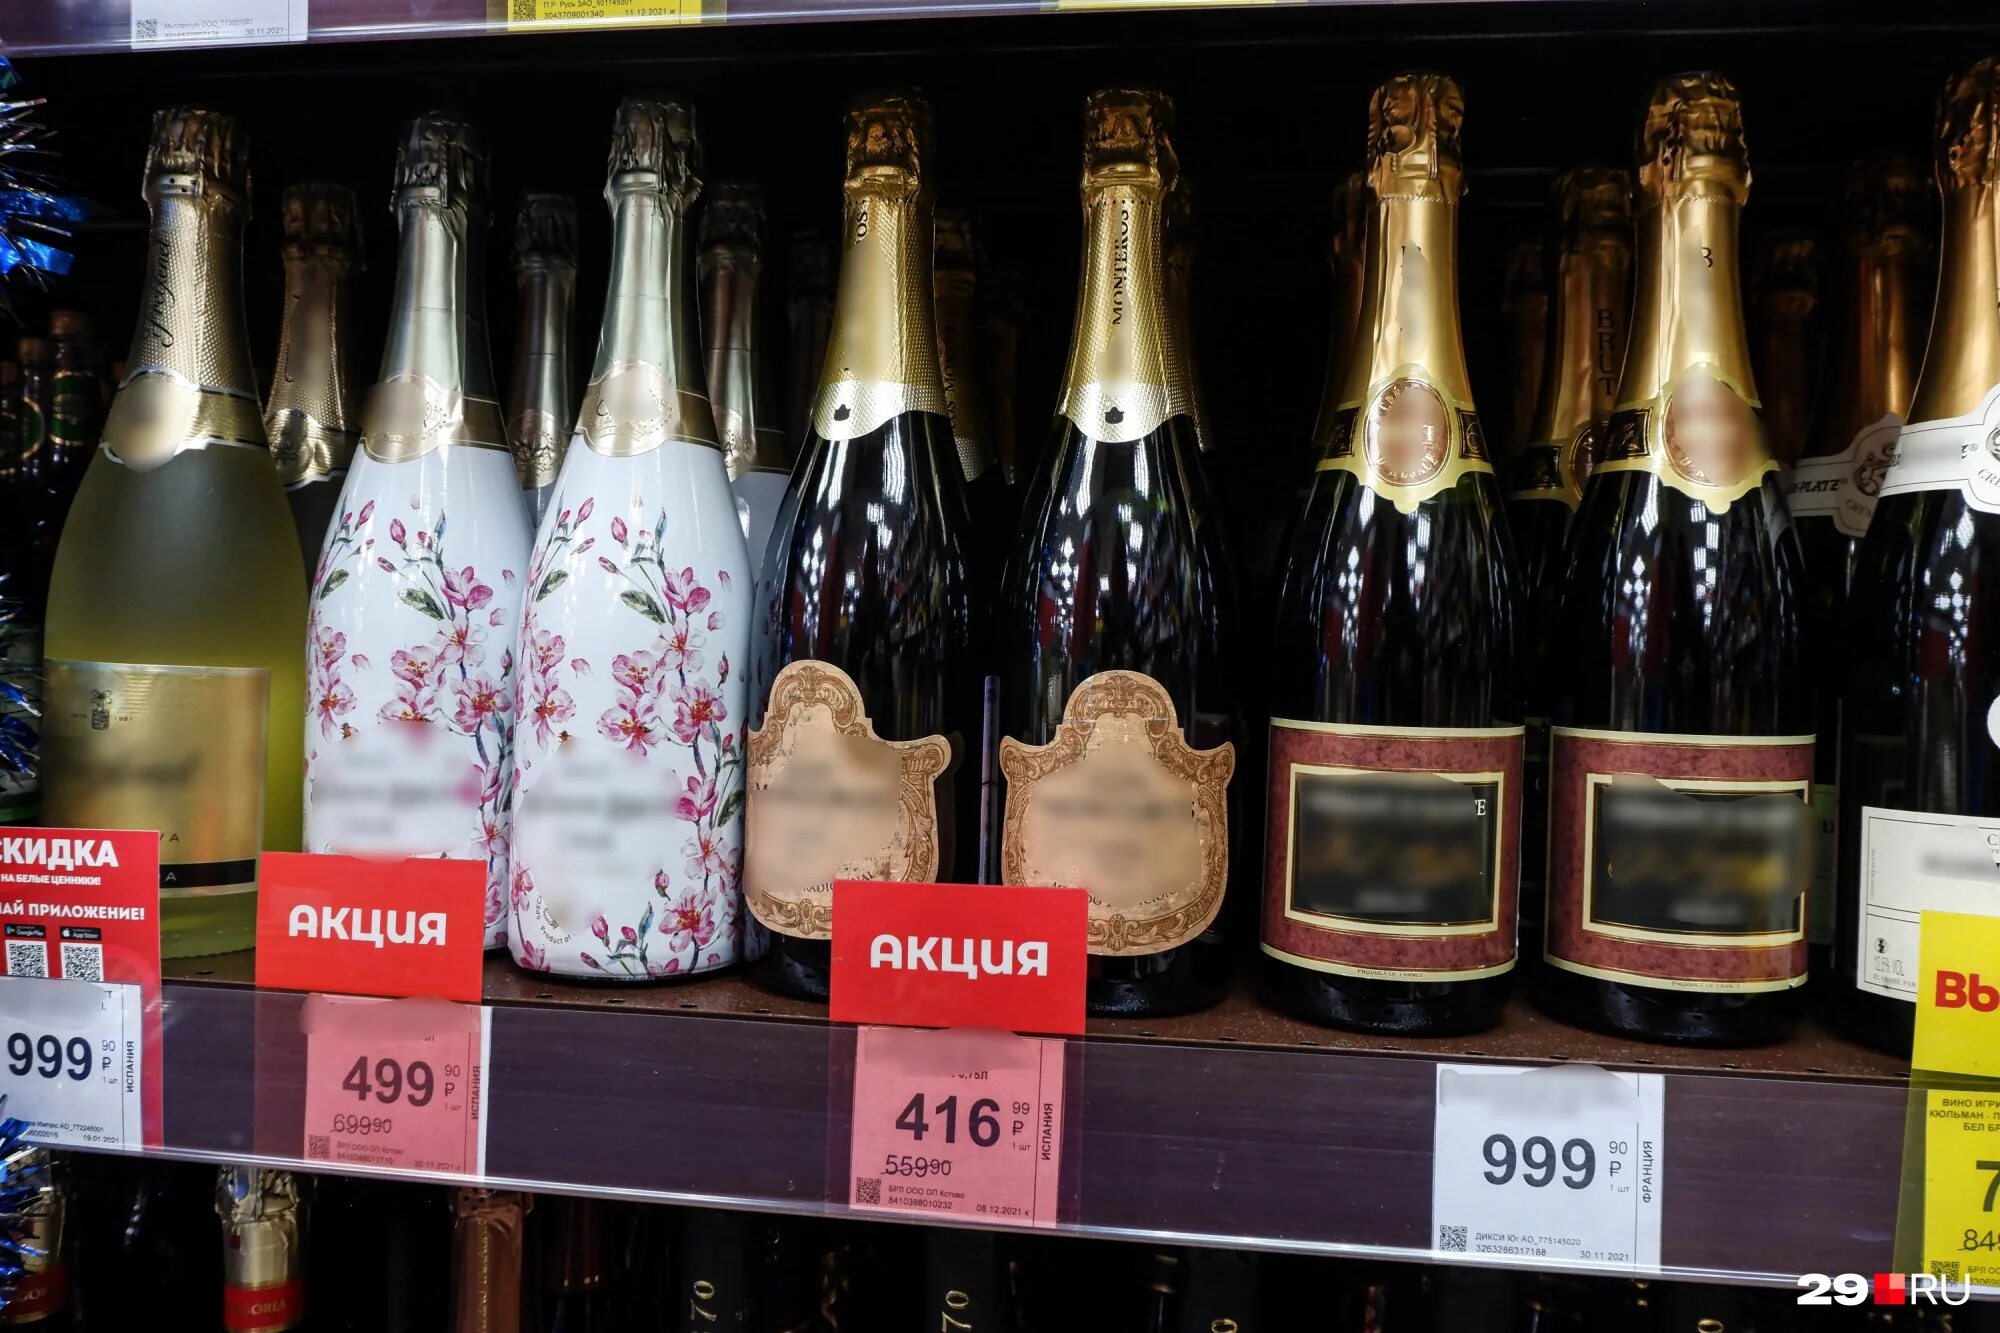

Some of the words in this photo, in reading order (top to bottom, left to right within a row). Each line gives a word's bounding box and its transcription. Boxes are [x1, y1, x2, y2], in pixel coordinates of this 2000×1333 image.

[16, 874, 50, 884] БЕЛЫЕ
[51, 875, 102, 886] ЦЕННИКИ!
[28, 903, 145, 921] ПРИЛОЖЕНИЕ!
[288, 904, 448, 949] АКЦИЯ
[870, 933, 1049, 980] АКЦИЯ
[101, 1040, 116, 1051] 90
[7, 1032, 92, 1081] 999
[125, 1040, 134, 1093] ИСПАНИЯ
[444, 1065, 461, 1077] 90
[342, 1056, 434, 1107] 499
[471, 1066, 481, 1120] ИСПАНИЯ
[1012, 1102, 1030, 1114] 99
[1942, 1098, 1973, 1108] ВИНО
[895, 1092, 1000, 1147] 416
[1929, 1110, 1984, 1120] КЮЛЬМАН
[1042, 1103, 1053, 1160] ИСПАНИЯ
[1963, 1122, 1985, 1132] БЕЛ
[1609, 1140, 1628, 1154] 90
[1482, 1133, 1596, 1189] 999
[1642, 1141, 1655, 1203] ФРАНЦИЯ
[888, 1185, 904, 1193] БРЛ
[906, 1187, 923, 1195] ООО
[926, 1188, 938, 1196] ОП
[888, 1197, 953, 1209] 8410388010232
[1475, 1232, 1505, 1241] ДИКСИ
[1475, 1244, 1547, 1256] 3263286317188
